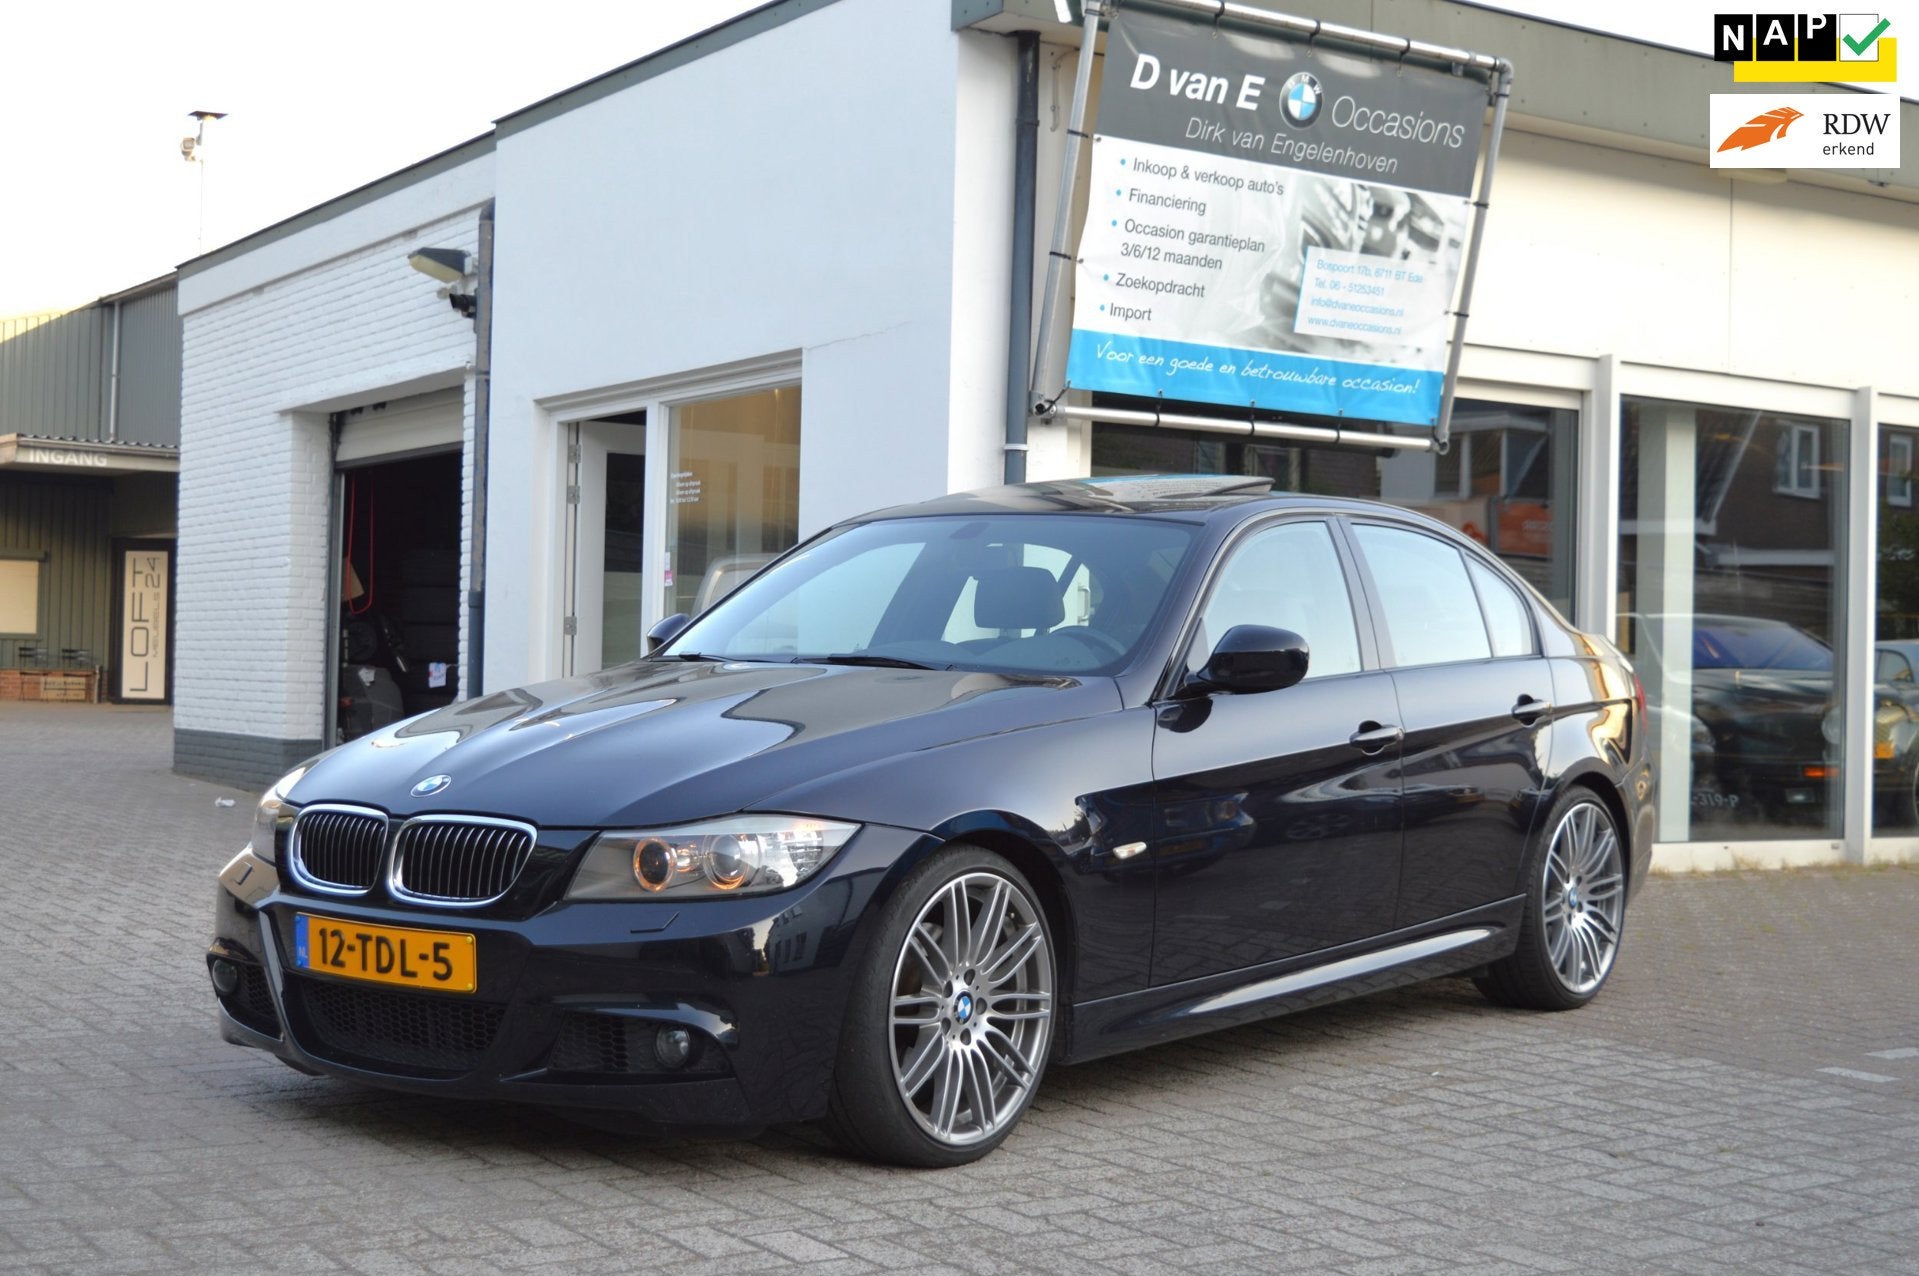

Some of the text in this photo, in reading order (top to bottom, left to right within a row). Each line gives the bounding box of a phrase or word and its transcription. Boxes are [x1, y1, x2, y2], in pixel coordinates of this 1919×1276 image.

[1130, 52, 1266, 111] D van E
[1331, 95, 1465, 149] Occasions
[1185, 117, 1398, 174] Dirk van Engelenhoven
[1133, 157, 1285, 196] Inkoop & verkoop auto's
[1128, 188, 1207, 217] Financiering
[1124, 218, 1265, 253] Occasion garantieplan
[1120, 242, 1223, 270] 3/6/12 maanden
[1115, 272, 1206, 298] Zoekopdracht
[1109, 302, 1152, 322] Import
[1096, 340, 1421, 395] Voor een goede en betrouwbare occasion!
[28, 449, 109, 467] INGANG
[145, 556, 162, 589] 24
[129, 557, 150, 693] LOFT
[319, 928, 454, 982] 12-TDL-5
